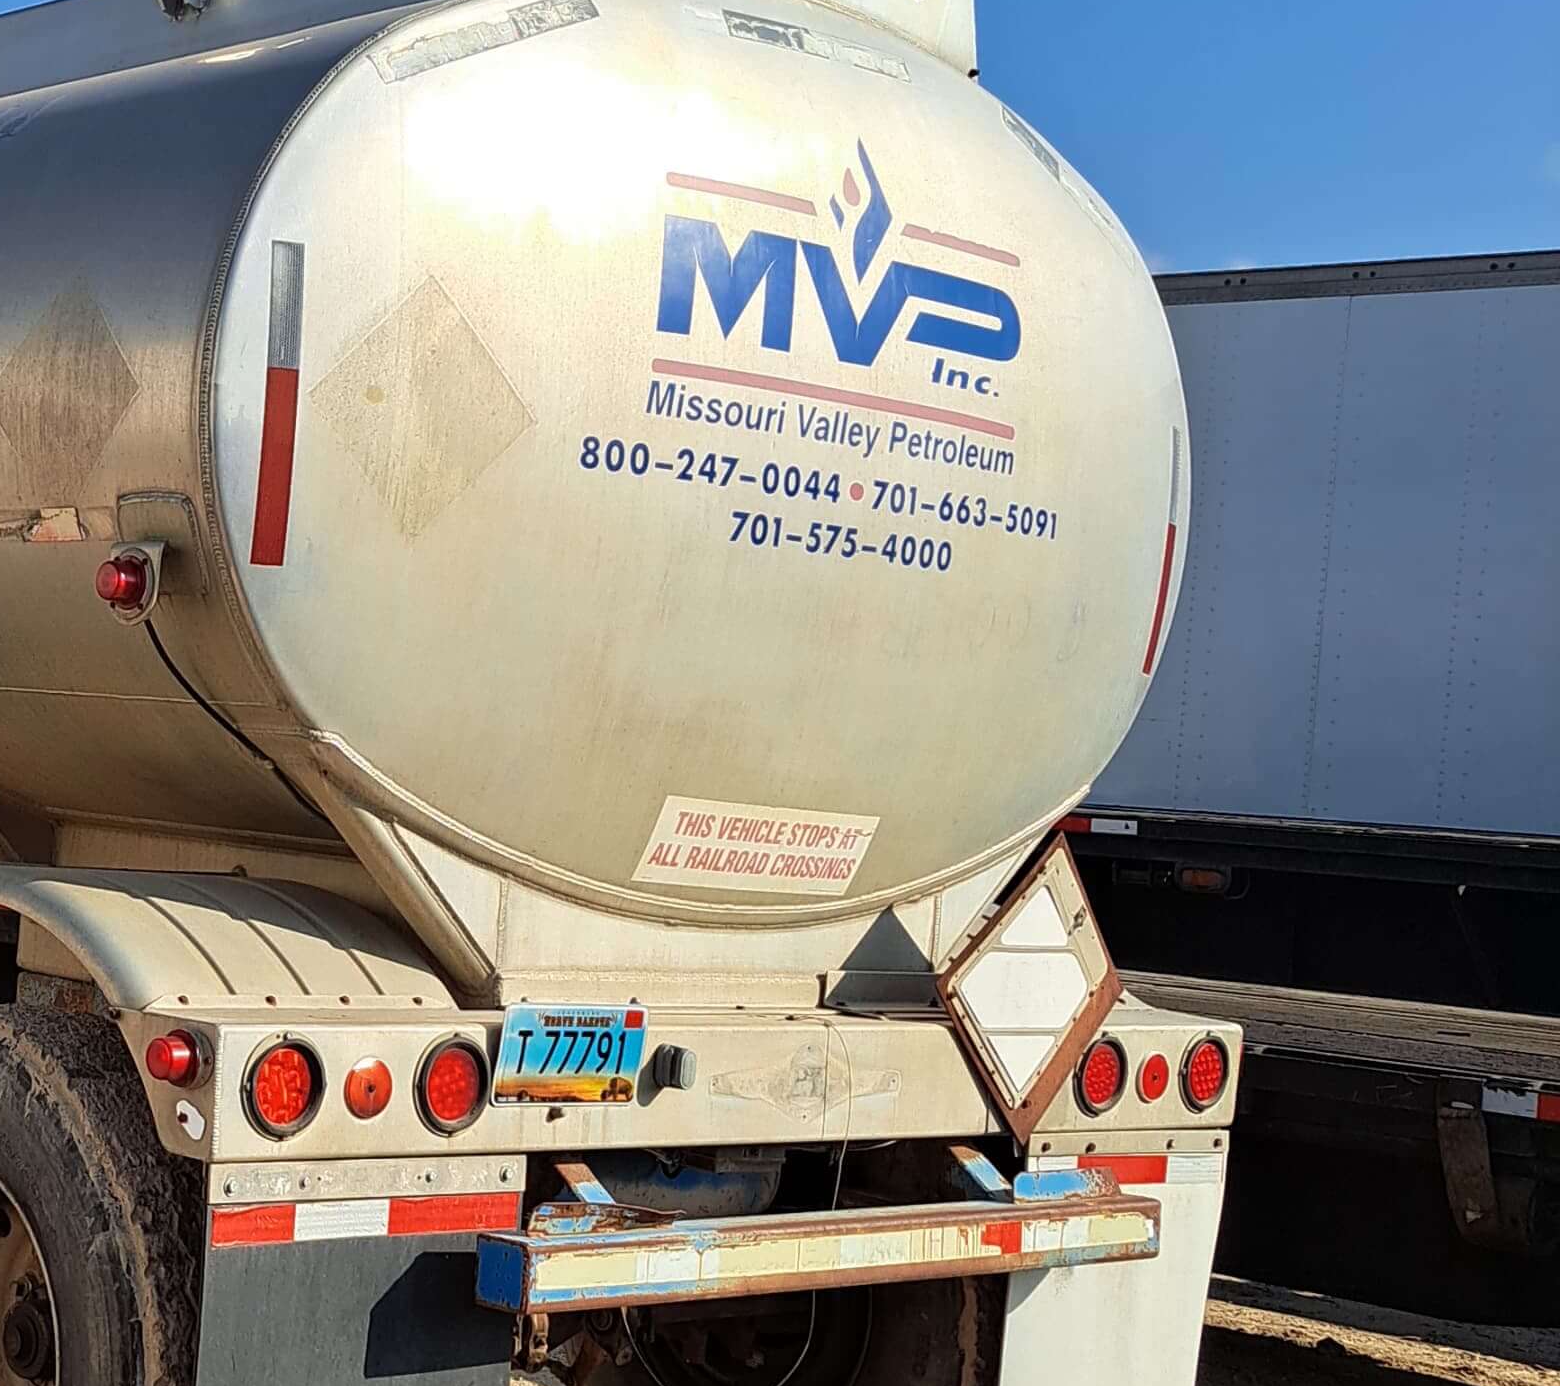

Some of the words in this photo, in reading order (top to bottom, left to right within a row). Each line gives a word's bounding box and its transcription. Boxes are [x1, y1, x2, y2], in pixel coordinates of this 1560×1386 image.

[656, 213, 1021, 367] MVP
[931, 358, 1000, 397] Inc.
[646, 380, 786, 434] Missouri
[799, 404, 880, 458] Valley
[889, 421, 1016, 475] Petroleum
[579, 436, 841, 503] 800-247-0044
[871, 480, 1058, 540] 701-663-5091
[729, 511, 953, 572] 701-575-4000
[674, 811, 716, 838] THIS
[717, 816, 788, 846] VEHICLE
[782, 822, 840, 849] STOPS
[647, 842, 680, 867] ALL
[683, 845, 769, 876] RAILROAD
[769, 853, 857, 881] CROSSINGS
[516, 1030, 534, 1075] T
[538, 1030, 626, 1075] 77791
